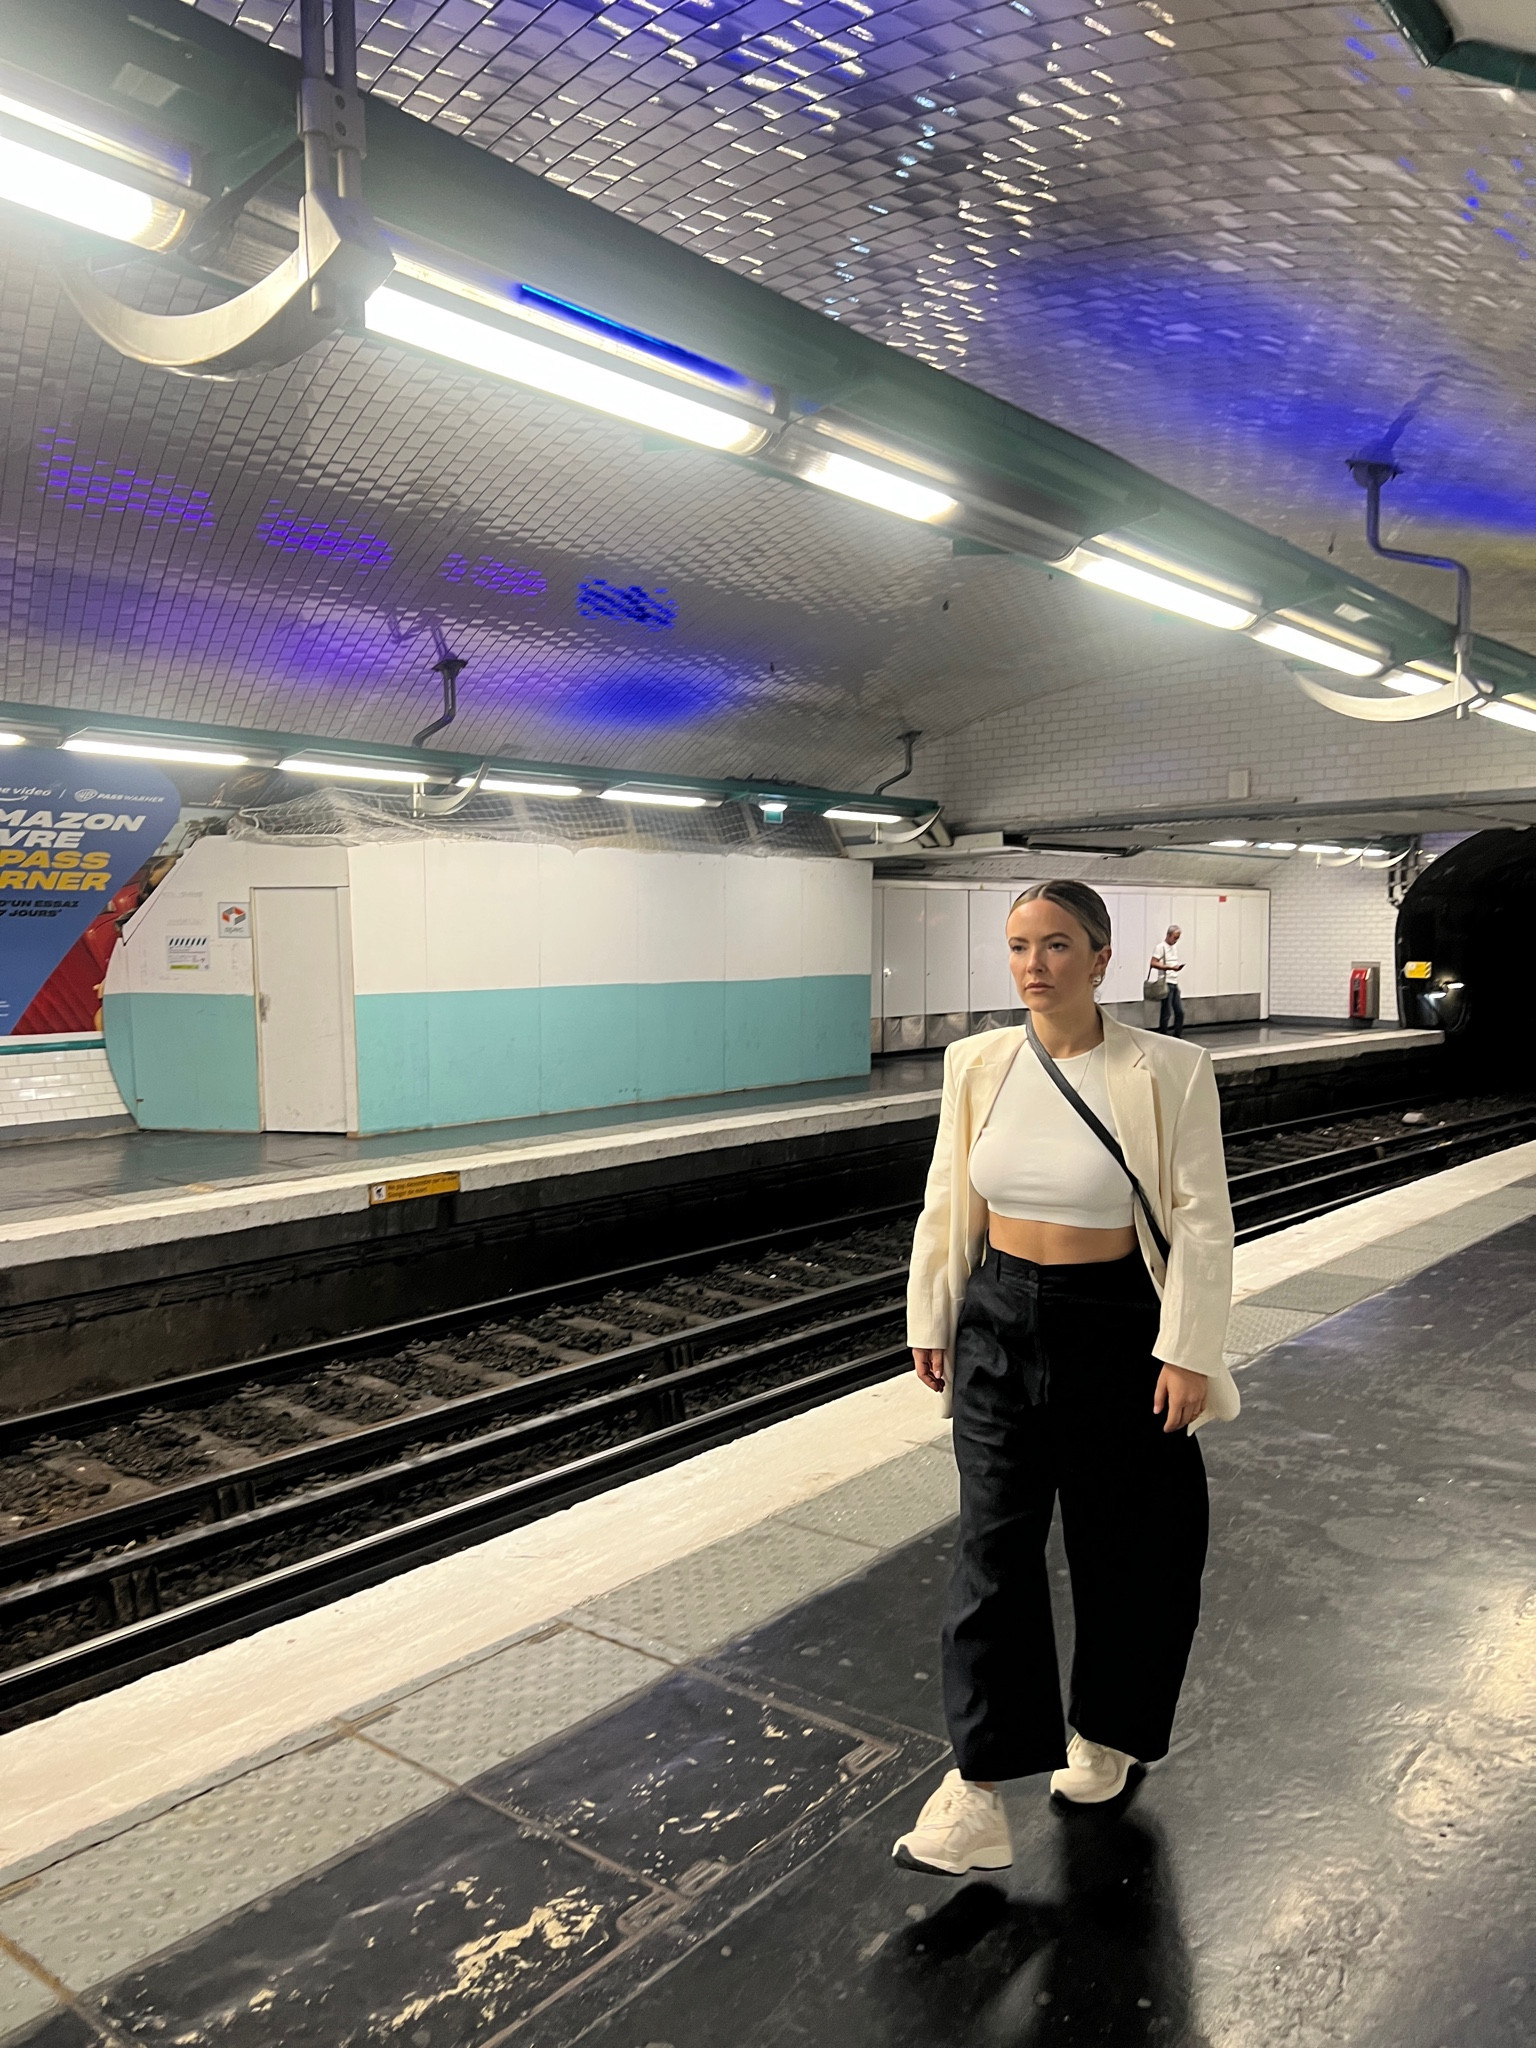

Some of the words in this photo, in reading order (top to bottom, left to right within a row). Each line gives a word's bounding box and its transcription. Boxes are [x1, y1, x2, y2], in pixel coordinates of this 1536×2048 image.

[13, 787, 52, 797] video
[0, 808, 146, 832] MAZON
[0, 849, 111, 870] PASS
[0, 870, 112, 891] RNER
